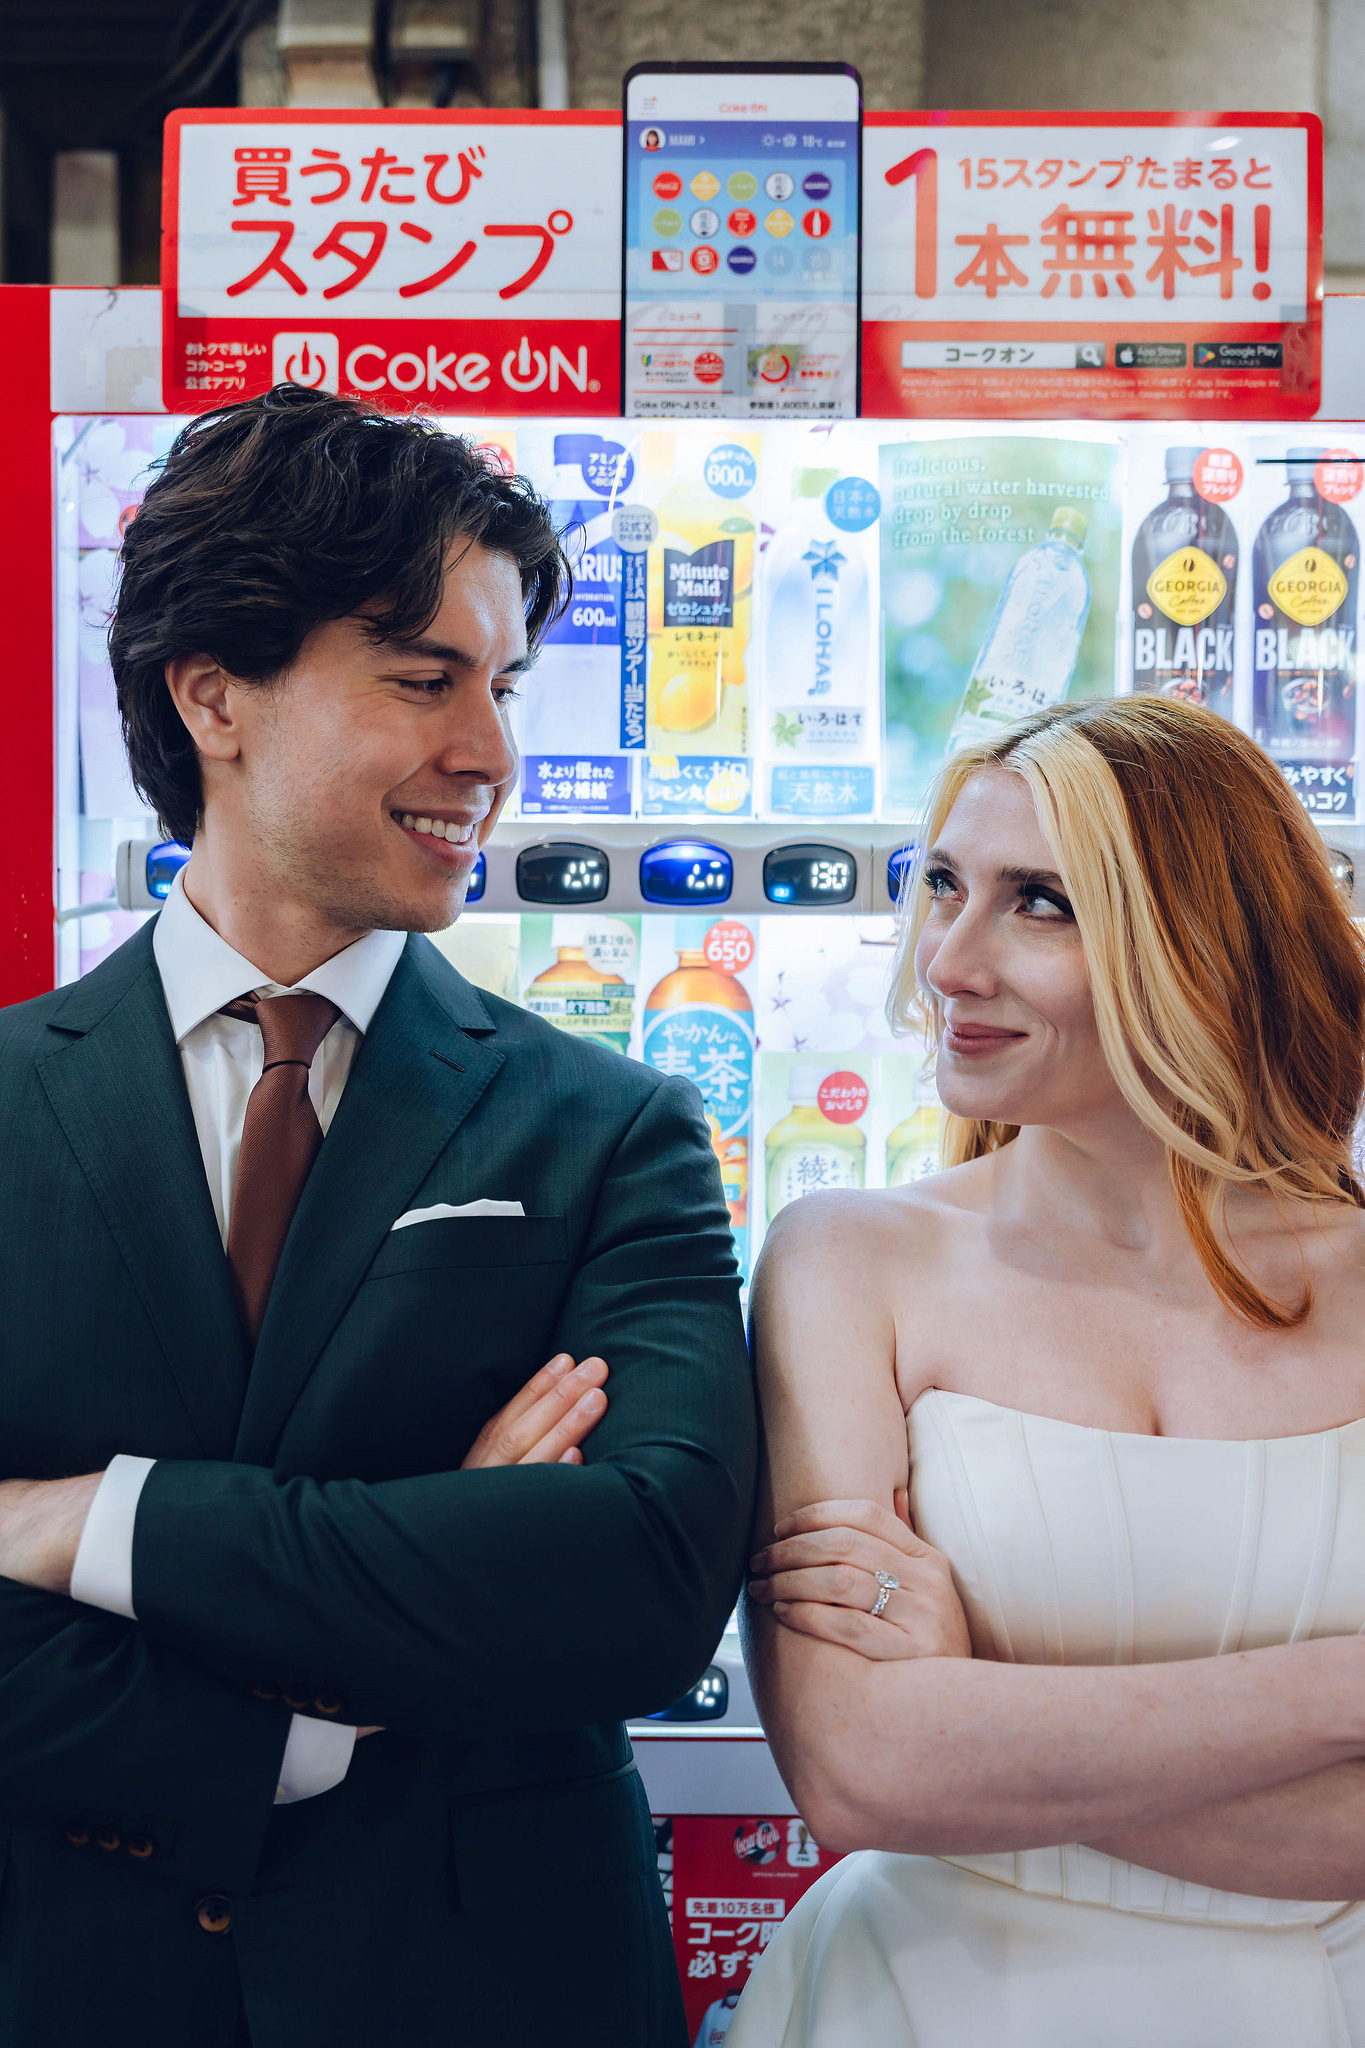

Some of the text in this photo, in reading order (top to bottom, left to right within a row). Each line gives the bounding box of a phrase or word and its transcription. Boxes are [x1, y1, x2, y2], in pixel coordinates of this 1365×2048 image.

[232, 145, 487, 207] 買うたび
[958, 156, 1273, 190] 15スタンプたまると
[226, 209, 574, 300] スタンプ
[184, 342, 267, 356] おトクで楽しい
[945, 348, 1035, 363] コークオン
[1219, 344, 1279, 359] Google Play
[185, 359, 247, 373] コカ・コーラ
[346, 345, 491, 391] Coke
[184, 375, 246, 390] 公式アプリ
[894, 478, 1110, 502] natural water harvested
[894, 503, 1013, 526] drop by drop
[894, 526, 1035, 548] from the forest
[669, 562, 730, 581] Minute
[676, 579, 722, 597] Maid
[1155, 580, 1220, 593] GEORGIA
[1276, 580, 1342, 593] GEORGIA
[666, 601, 732, 617] ゼロシュガー
[1135, 627, 1234, 671] BLACK
[1256, 627, 1356, 672] BLACK
[538, 761, 615, 780] 水より優れた
[789, 781, 858, 805] 天然水
[811, 861, 849, 891] 130
[707, 940, 751, 962] 650
[820, 1087, 867, 1099] こだわりの
